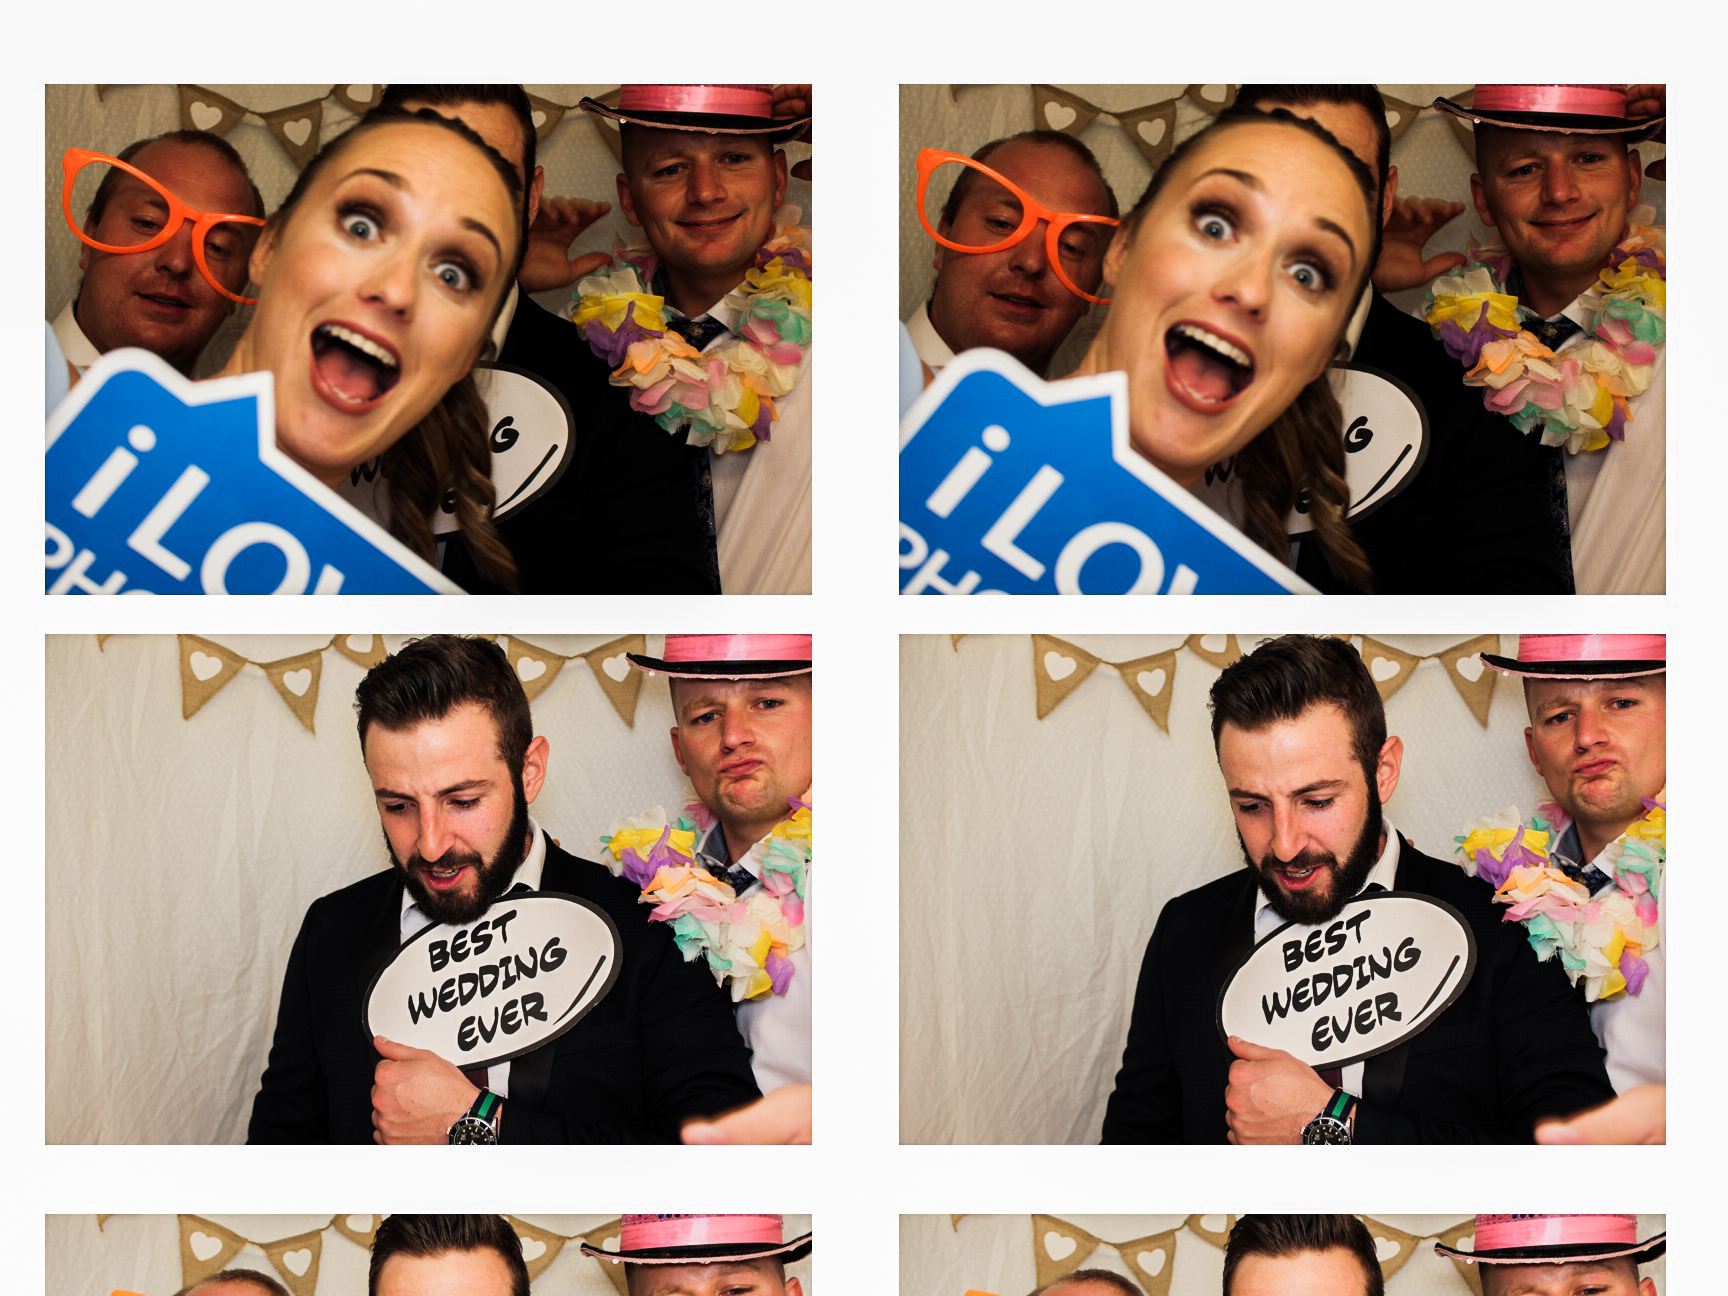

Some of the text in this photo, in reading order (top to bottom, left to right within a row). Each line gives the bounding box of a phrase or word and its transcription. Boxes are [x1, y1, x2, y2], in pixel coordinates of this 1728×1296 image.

[428, 909, 518, 973] BEST
[1282, 909, 1372, 973] BEST
[407, 936, 568, 1025] WEDDING
[1261, 936, 1422, 1025] WEDDING
[457, 991, 549, 1052] EVER
[1311, 991, 1403, 1052] EVER
